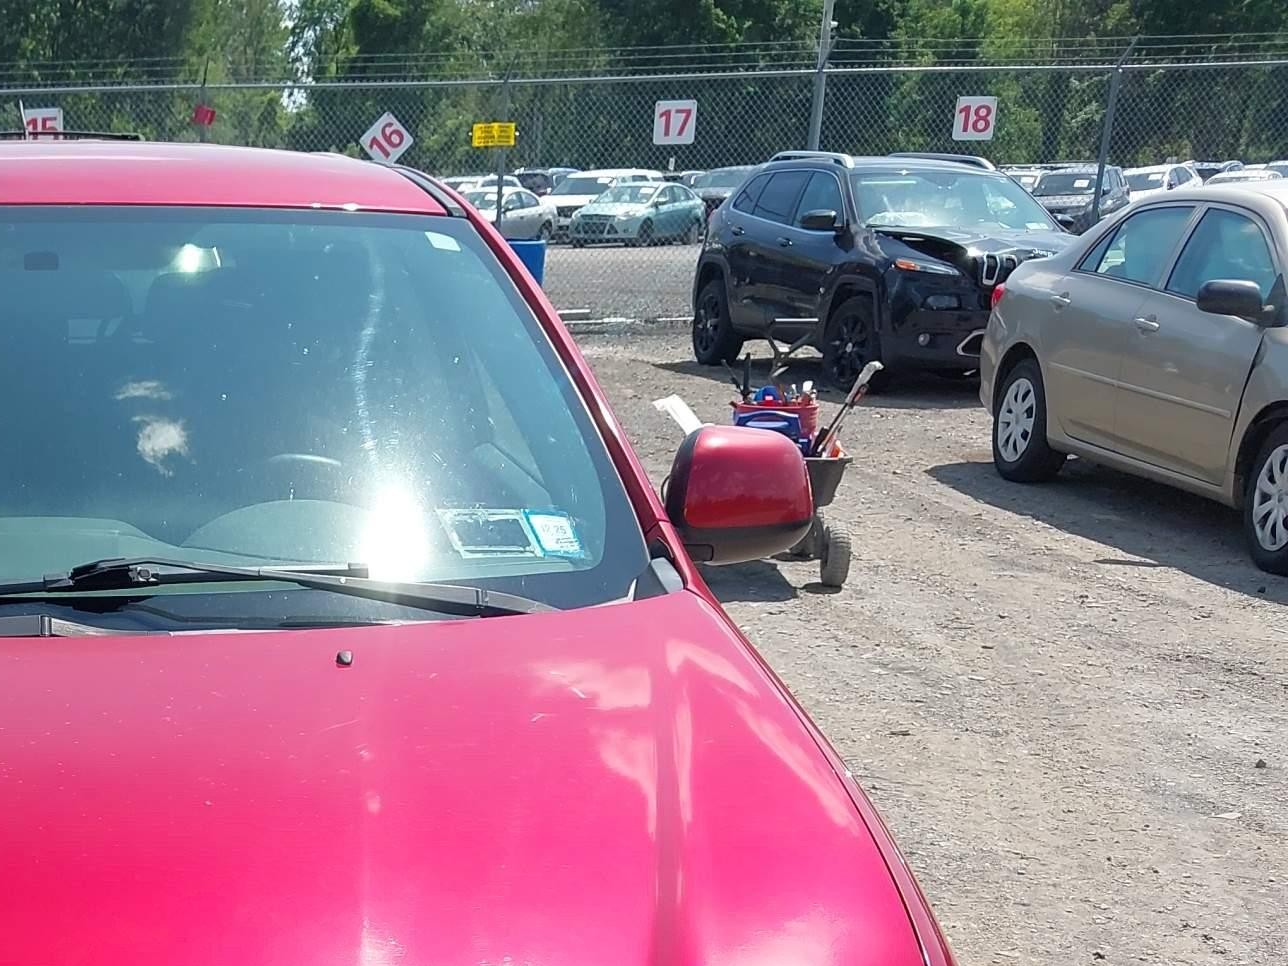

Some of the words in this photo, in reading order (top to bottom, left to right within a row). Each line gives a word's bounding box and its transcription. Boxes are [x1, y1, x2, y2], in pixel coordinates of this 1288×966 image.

[659, 108, 692, 138] 17
[959, 104, 992, 133] 18
[369, 122, 405, 160] 16
